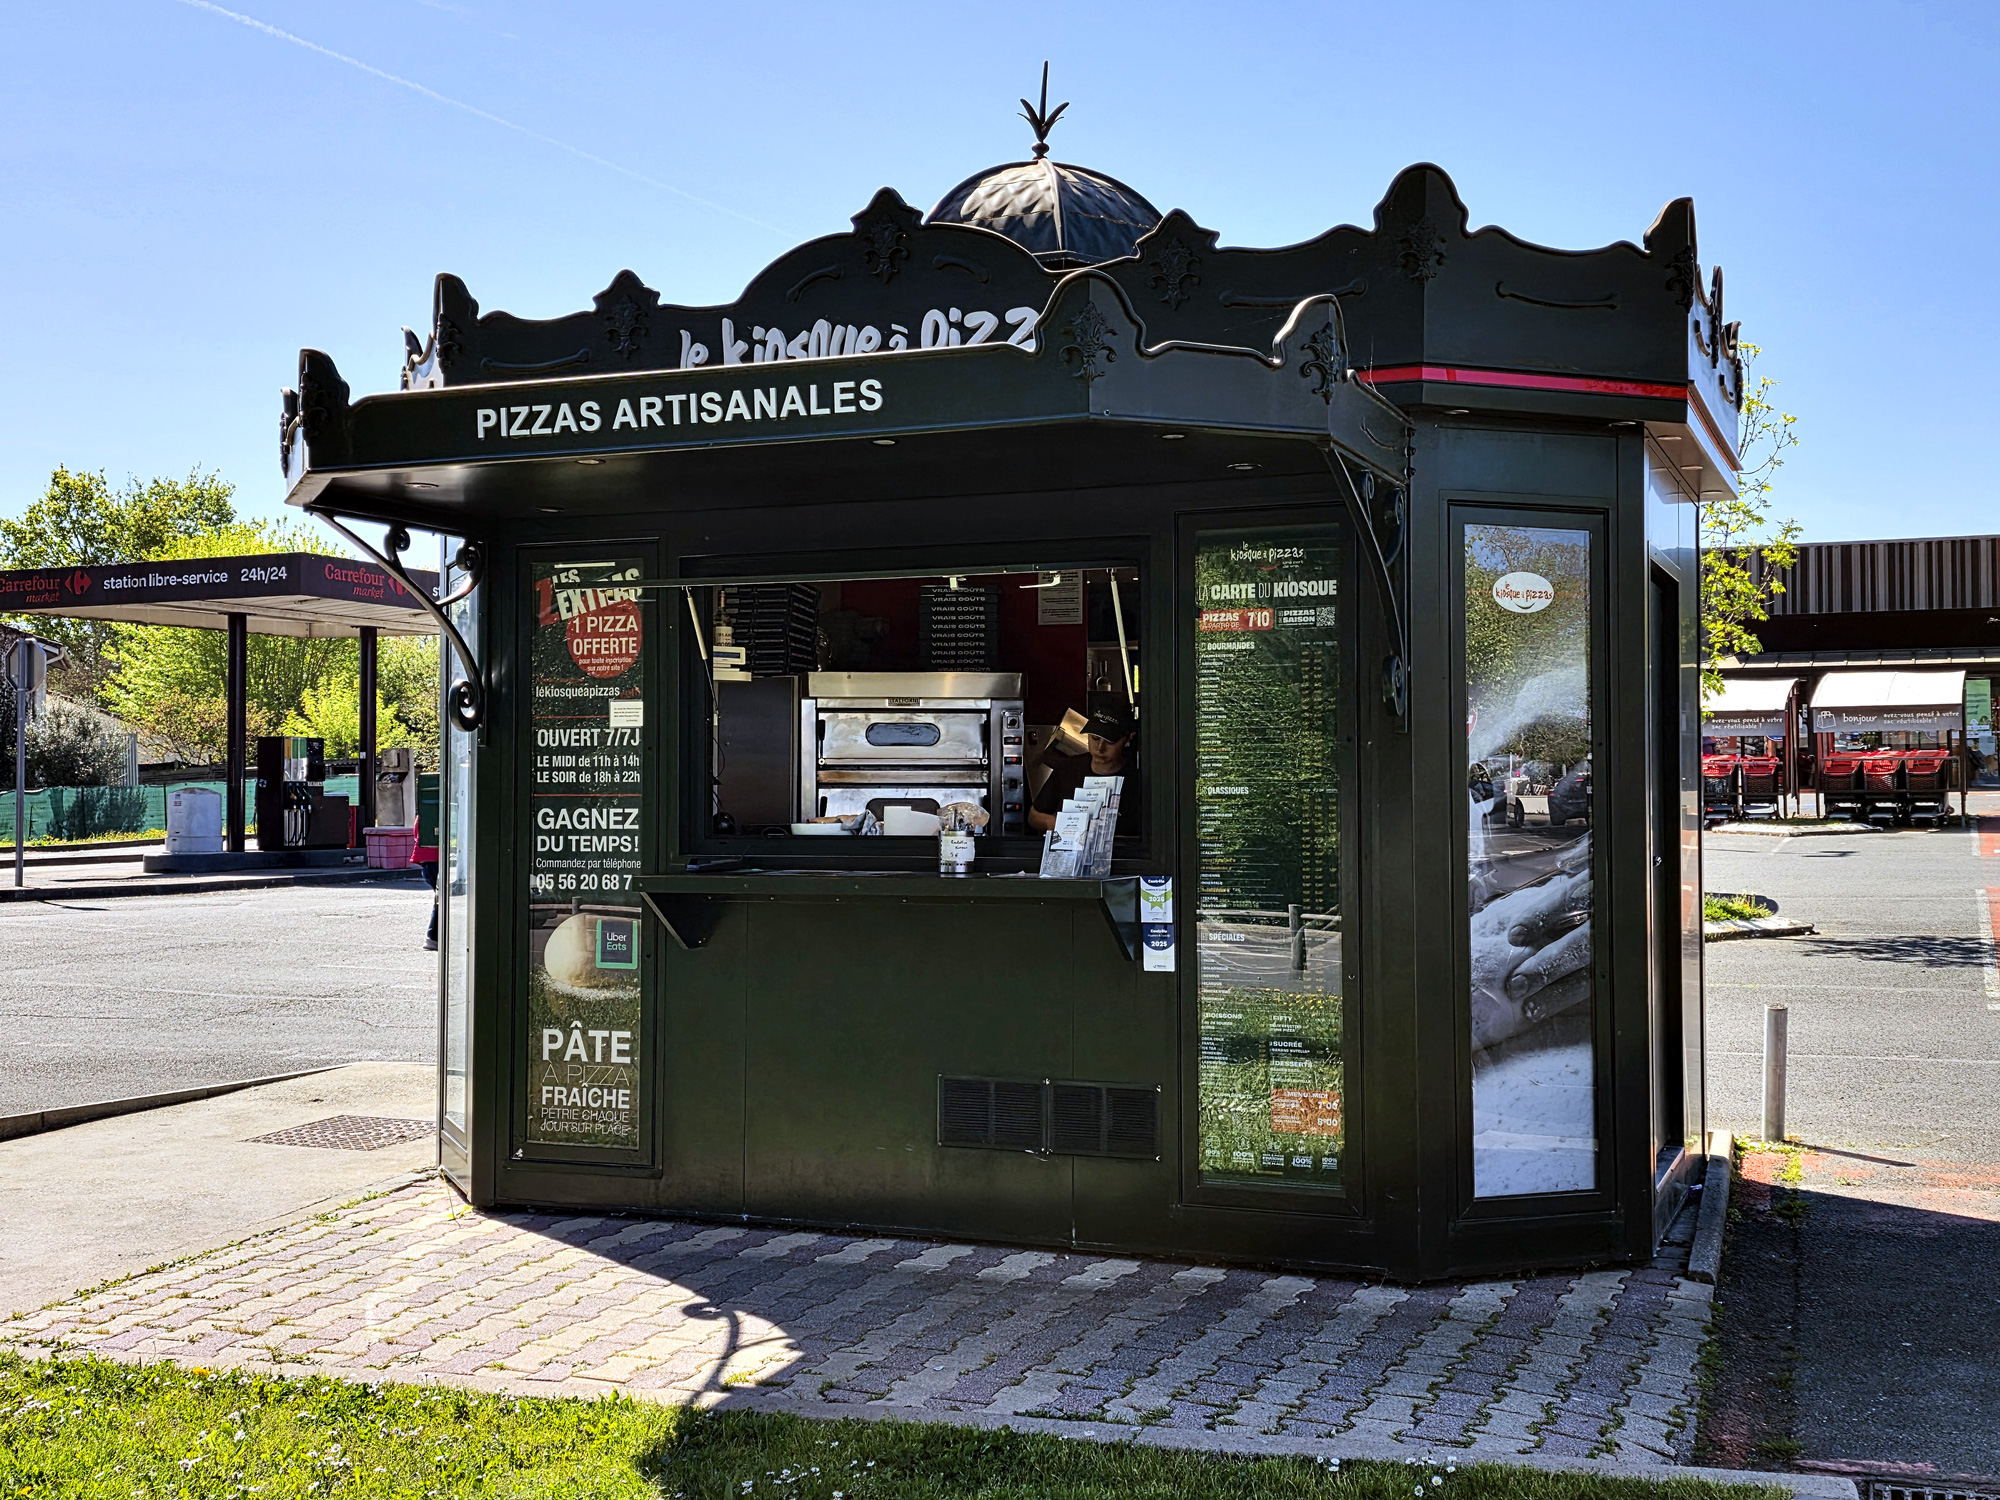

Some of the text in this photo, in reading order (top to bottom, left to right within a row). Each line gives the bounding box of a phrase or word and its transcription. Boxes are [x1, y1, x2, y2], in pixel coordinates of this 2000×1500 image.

[476, 378, 883, 439] PIZZAS ARTISANALES
[1230, 548, 1261, 562] kiosque
[1269, 547, 1304, 562] pizzas
[103, 566, 287, 590] station libre-service 24h/24
[325, 563, 385, 586] Carrefour
[353, 586, 384, 598] market
[1211, 583, 1256, 600] CARTE
[1258, 582, 1271, 598] DU
[1273, 580, 1337, 598] KIOSQUE
[1496, 587, 1520, 600] kiosque
[1526, 589, 1553, 602] pizzas
[26, 593, 60, 603] market
[573, 615, 638, 634] 1 PIZZA
[1203, 612, 1240, 623] PIZZAS
[573, 637, 638, 655] OFFERTE
[1843, 713, 1878, 725] bonjour
[1916, 710, 1935, 718] pensé
[537, 728, 640, 747] OUVERT 7/7J
[537, 755, 640, 767] LE MIDI de 11h à 14h
[537, 771, 640, 783] LE SOIR de 18h à 22h
[1208, 786, 1249, 795] CLASSIQUES
[537, 808, 639, 830] GAGNEZ
[537, 835, 564, 852] DU
[536, 857, 641, 871] Commandez par téléphone
[536, 873, 632, 890] 05 56 20 68 7
[606, 932, 627, 941] Uber
[1208, 931, 1245, 941] SPÉCIALES
[606, 942, 627, 950] Eats
[542, 1020, 631, 1064] PÂTE
[542, 1060, 630, 1086] À PIZZA
[541, 1083, 630, 1109] FRAÎCHE
[582, 1109, 629, 1123] CHAQUE
[571, 1121, 592, 1133] SUR
